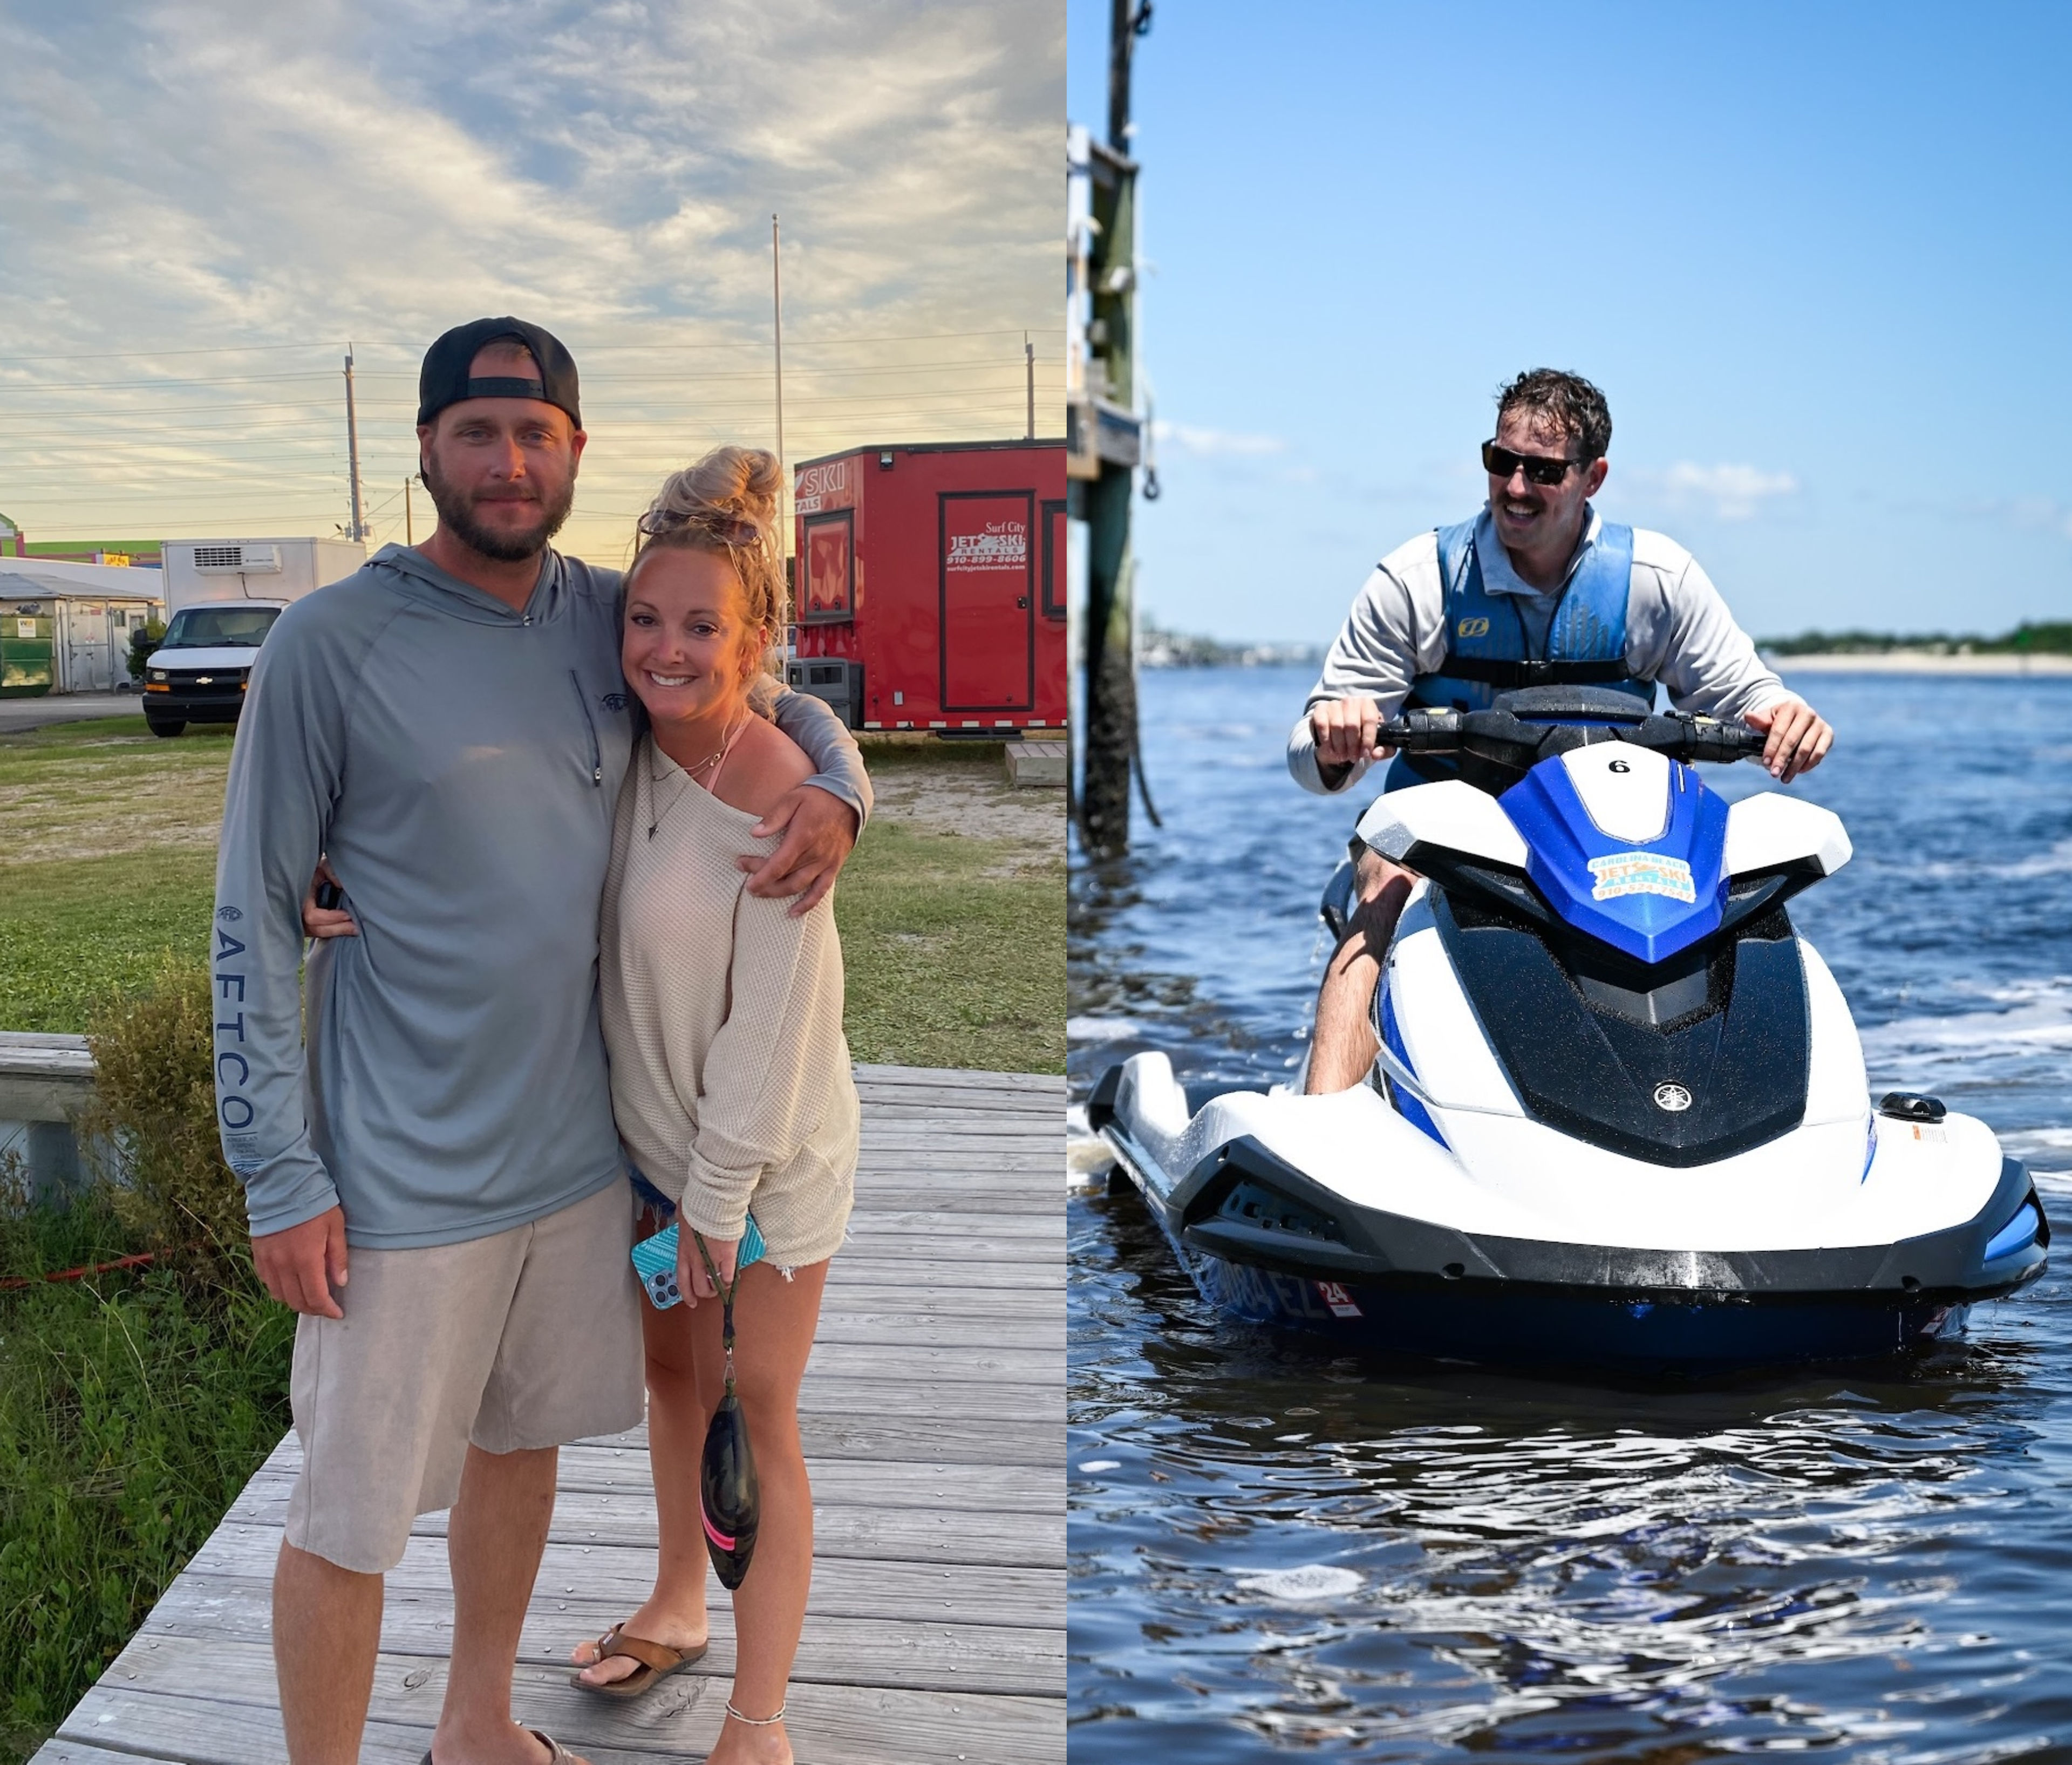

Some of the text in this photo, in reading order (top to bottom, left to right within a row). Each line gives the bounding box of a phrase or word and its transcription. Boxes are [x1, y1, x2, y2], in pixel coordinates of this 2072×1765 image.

[805, 462, 844, 496] SKI
[986, 521, 1025, 534] Surf City
[951, 534, 1023, 550] JET SKI
[946, 555, 1026, 564] 910-899-8606
[946, 564, 1025, 573] surfcityjetskirentals.com
[1608, 760, 1630, 773] 6
[1592, 855, 1686, 870] CAROLINA BEACH
[1599, 864, 1687, 882] JET SKI
[216, 927, 254, 1129] AFTCO
[1318, 1282, 1349, 1303] 24
